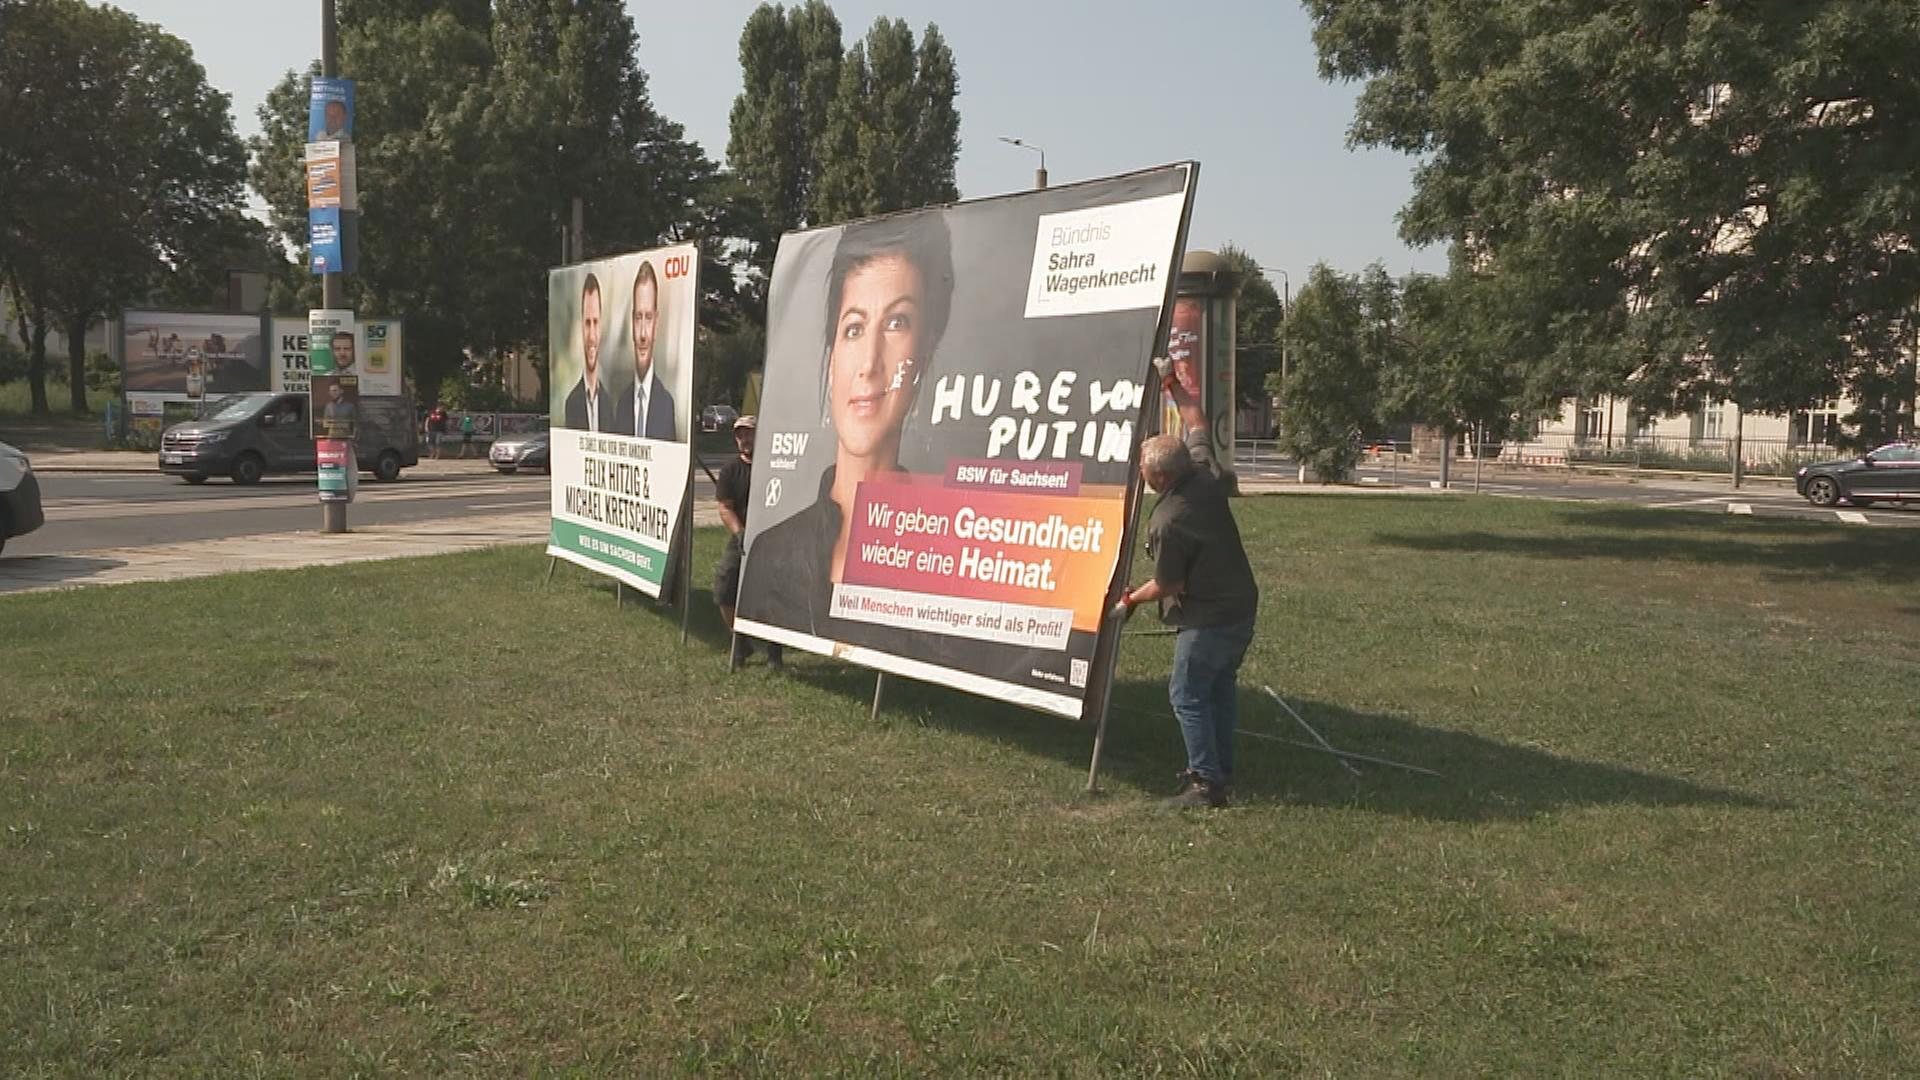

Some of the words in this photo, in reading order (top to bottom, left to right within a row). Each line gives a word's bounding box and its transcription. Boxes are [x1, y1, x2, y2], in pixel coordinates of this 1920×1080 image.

[1051, 221, 1111, 247] Bündnis
[665, 255, 690, 280] CDU
[1046, 263, 1156, 295] Wagenknecht
[1048, 251, 1095, 271] Sahra
[283, 335, 308, 351] KE
[931, 371, 1077, 425] HURE
[771, 432, 809, 456] BSW
[987, 416, 1132, 462] PUTIN
[584, 456, 607, 487] FELIX
[609, 461, 640, 497] HITZIG
[642, 467, 650, 499] &
[956, 466, 988, 483] BSW
[989, 468, 1009, 485] für
[1010, 467, 1069, 488] Sachsen!
[566, 485, 603, 522] MICHAEL
[605, 495, 668, 542] KRETSCHMER
[867, 502, 894, 529] Wir
[895, 507, 949, 536] geben
[954, 507, 1104, 552] Gesundheit
[861, 539, 914, 569] wieder
[916, 547, 954, 575] eine
[958, 547, 1057, 591] Heimat.
[839, 594, 859, 610] Weil
[861, 596, 913, 619] Menschen
[917, 605, 972, 628] wichtiger
[975, 612, 1001, 630] sind
[1005, 616, 1024, 634] als
[1026, 618, 1064, 638] Profit!
